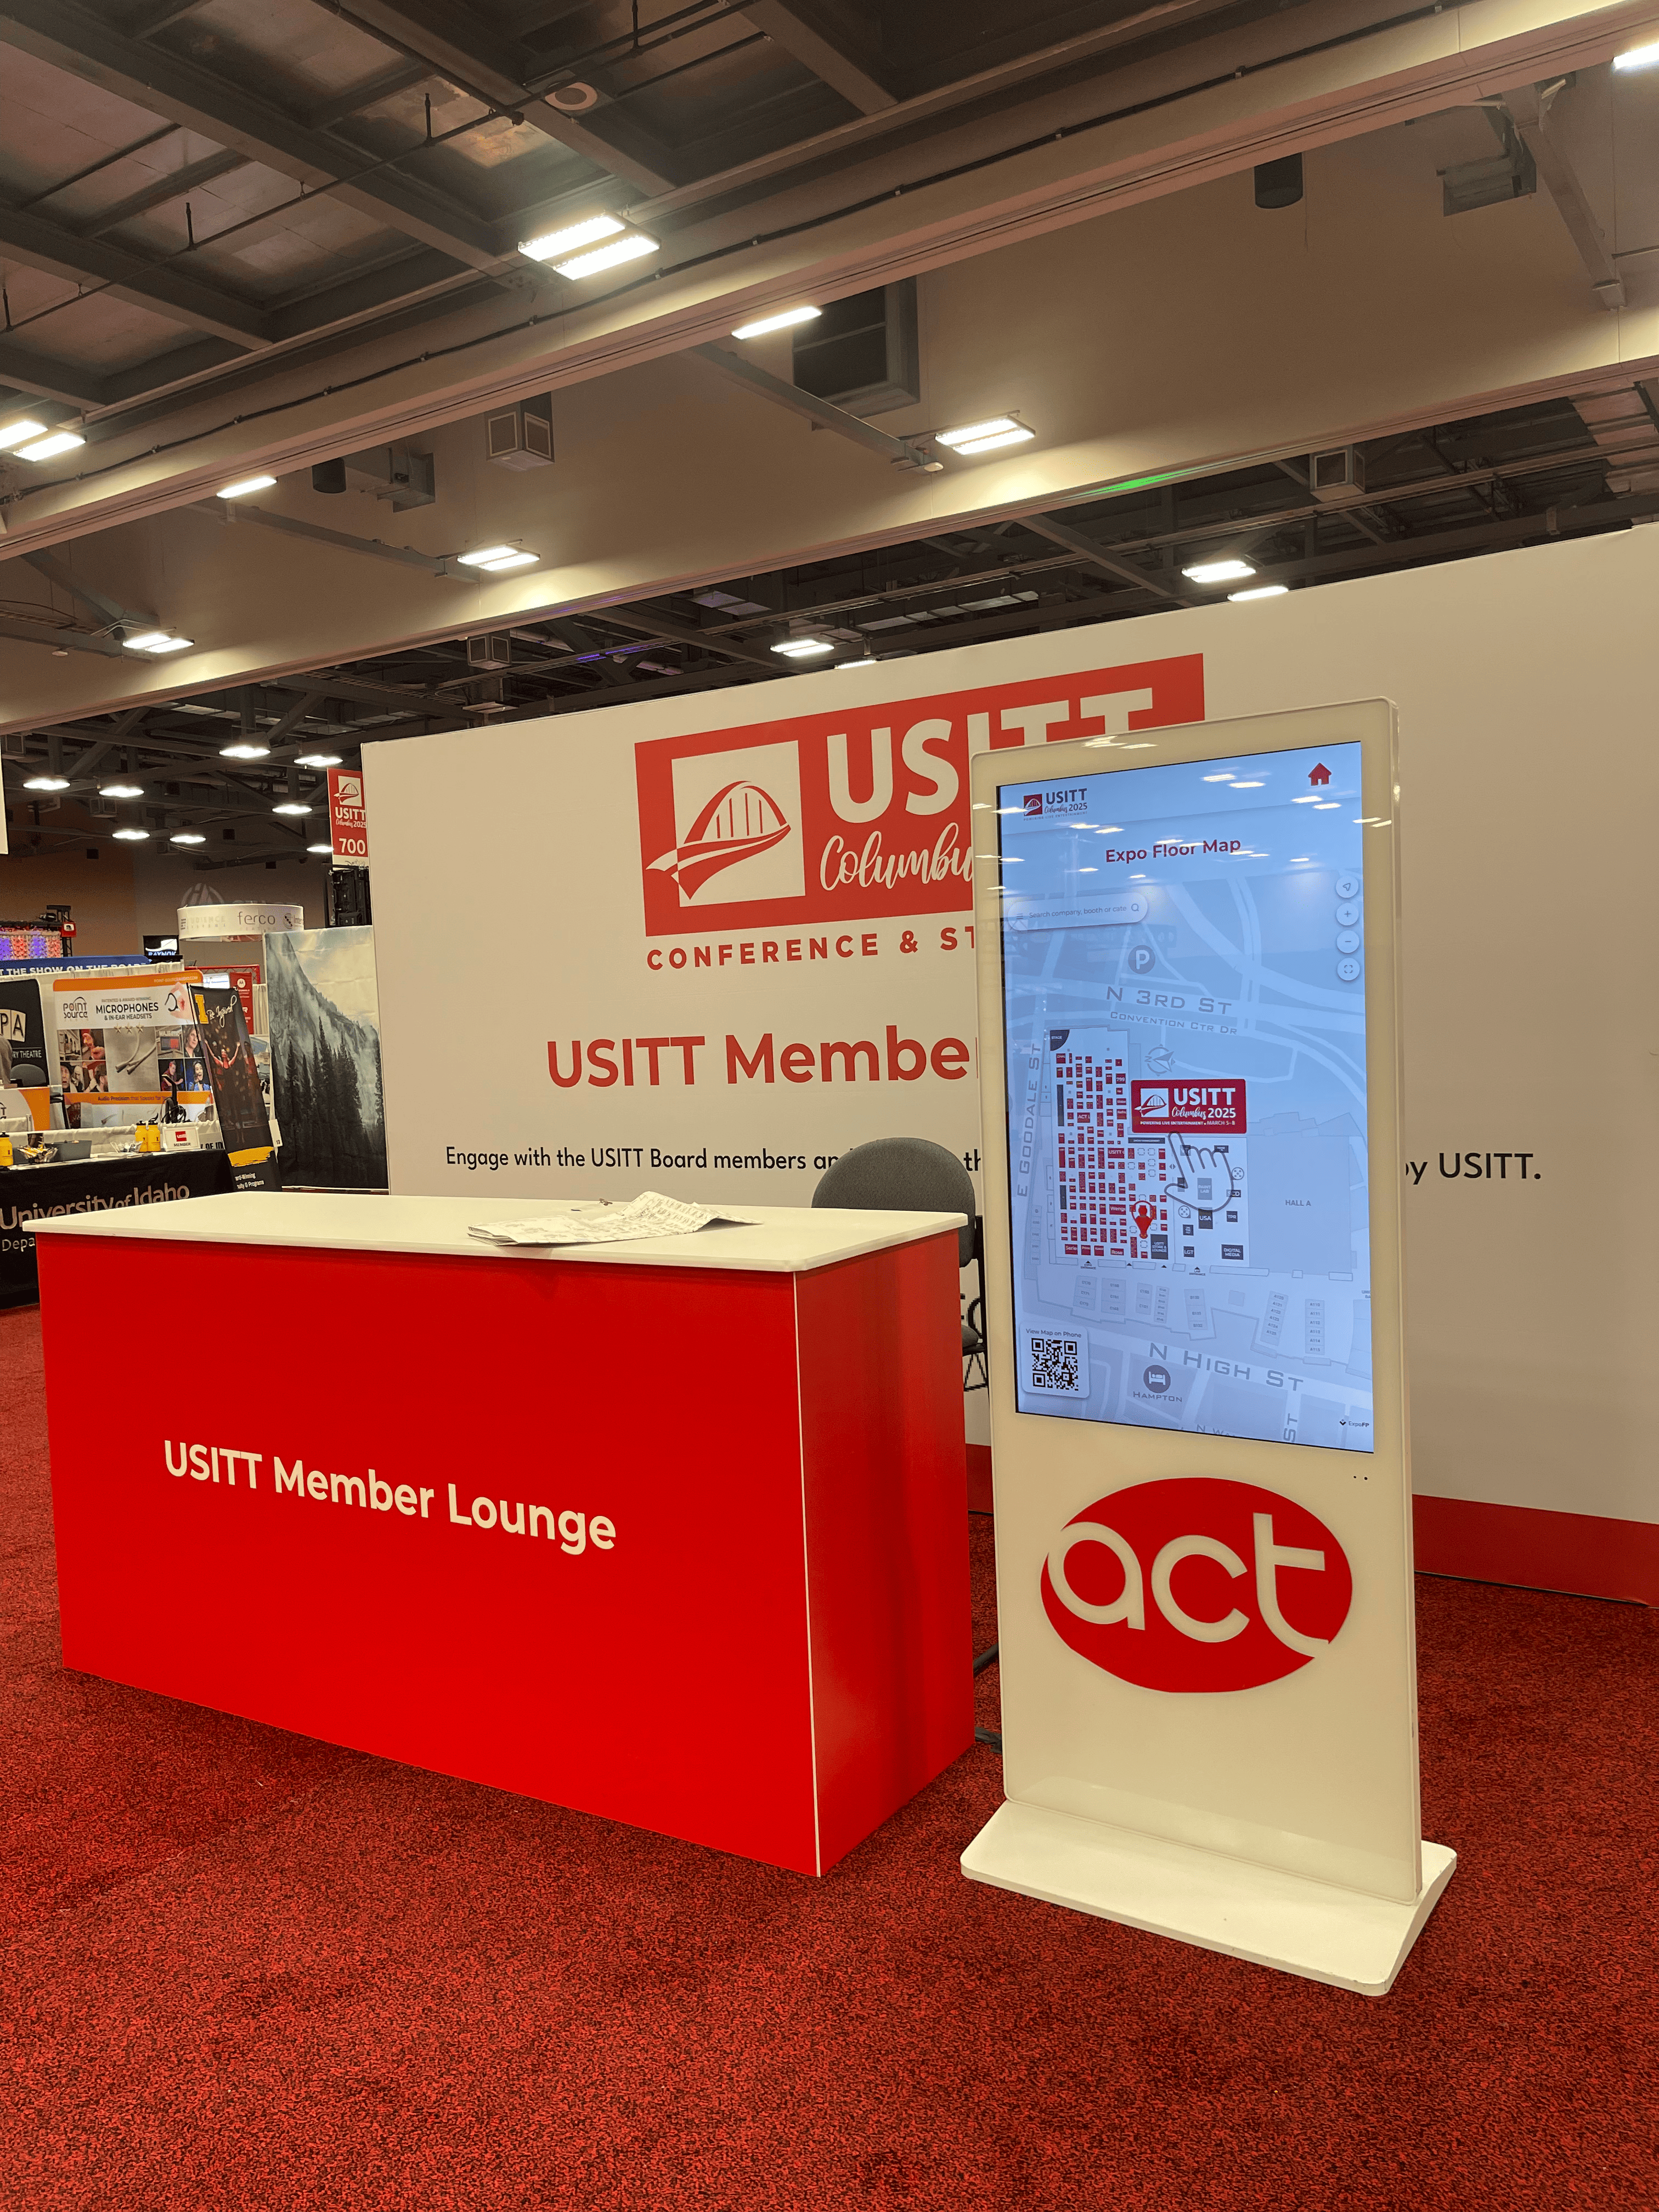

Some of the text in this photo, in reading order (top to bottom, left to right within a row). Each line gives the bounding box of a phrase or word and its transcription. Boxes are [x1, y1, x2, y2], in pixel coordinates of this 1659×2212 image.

[1046, 788, 1087, 804] USITT
[1069, 803, 1087, 811] 2025
[335, 806, 366, 821] USITT
[338, 838, 366, 855] 700
[1105, 839, 1241, 864] Expo Floor Map
[237, 911, 275, 926] ferco
[647, 933, 878, 970] CONFERENCE
[899, 930, 918, 953] &
[30, 966, 63, 975] SHOW
[95, 1002, 159, 1014] MICROPHONES
[1106, 986, 1232, 1014] N 3RD ST
[20, 1049, 42, 1058] THEATRE
[548, 1025, 979, 1088] USITT Membe
[1173, 1087, 1236, 1106] USITT
[1017, 1043, 1041, 1197] E GOODALE ST
[1171, 1106, 1237, 1120] Columbus 2025
[445, 1146, 509, 1171] Engage
[514, 1147, 551, 1166] with
[556, 1147, 585, 1167] the
[591, 1148, 644, 1167] USITT
[651, 1148, 707, 1168] Board
[714, 1148, 806, 1170] members
[1405, 1161, 1428, 1185] y
[1438, 1152, 1541, 1180] USITT.
[0, 1183, 190, 1229] University of Idaho
[1149, 1342, 1304, 1391] N HIGH ST
[1282, 1413, 1299, 1443] ST
[164, 1440, 617, 1555] USITT Member Lounge
[1047, 1512, 1330, 1658] act
